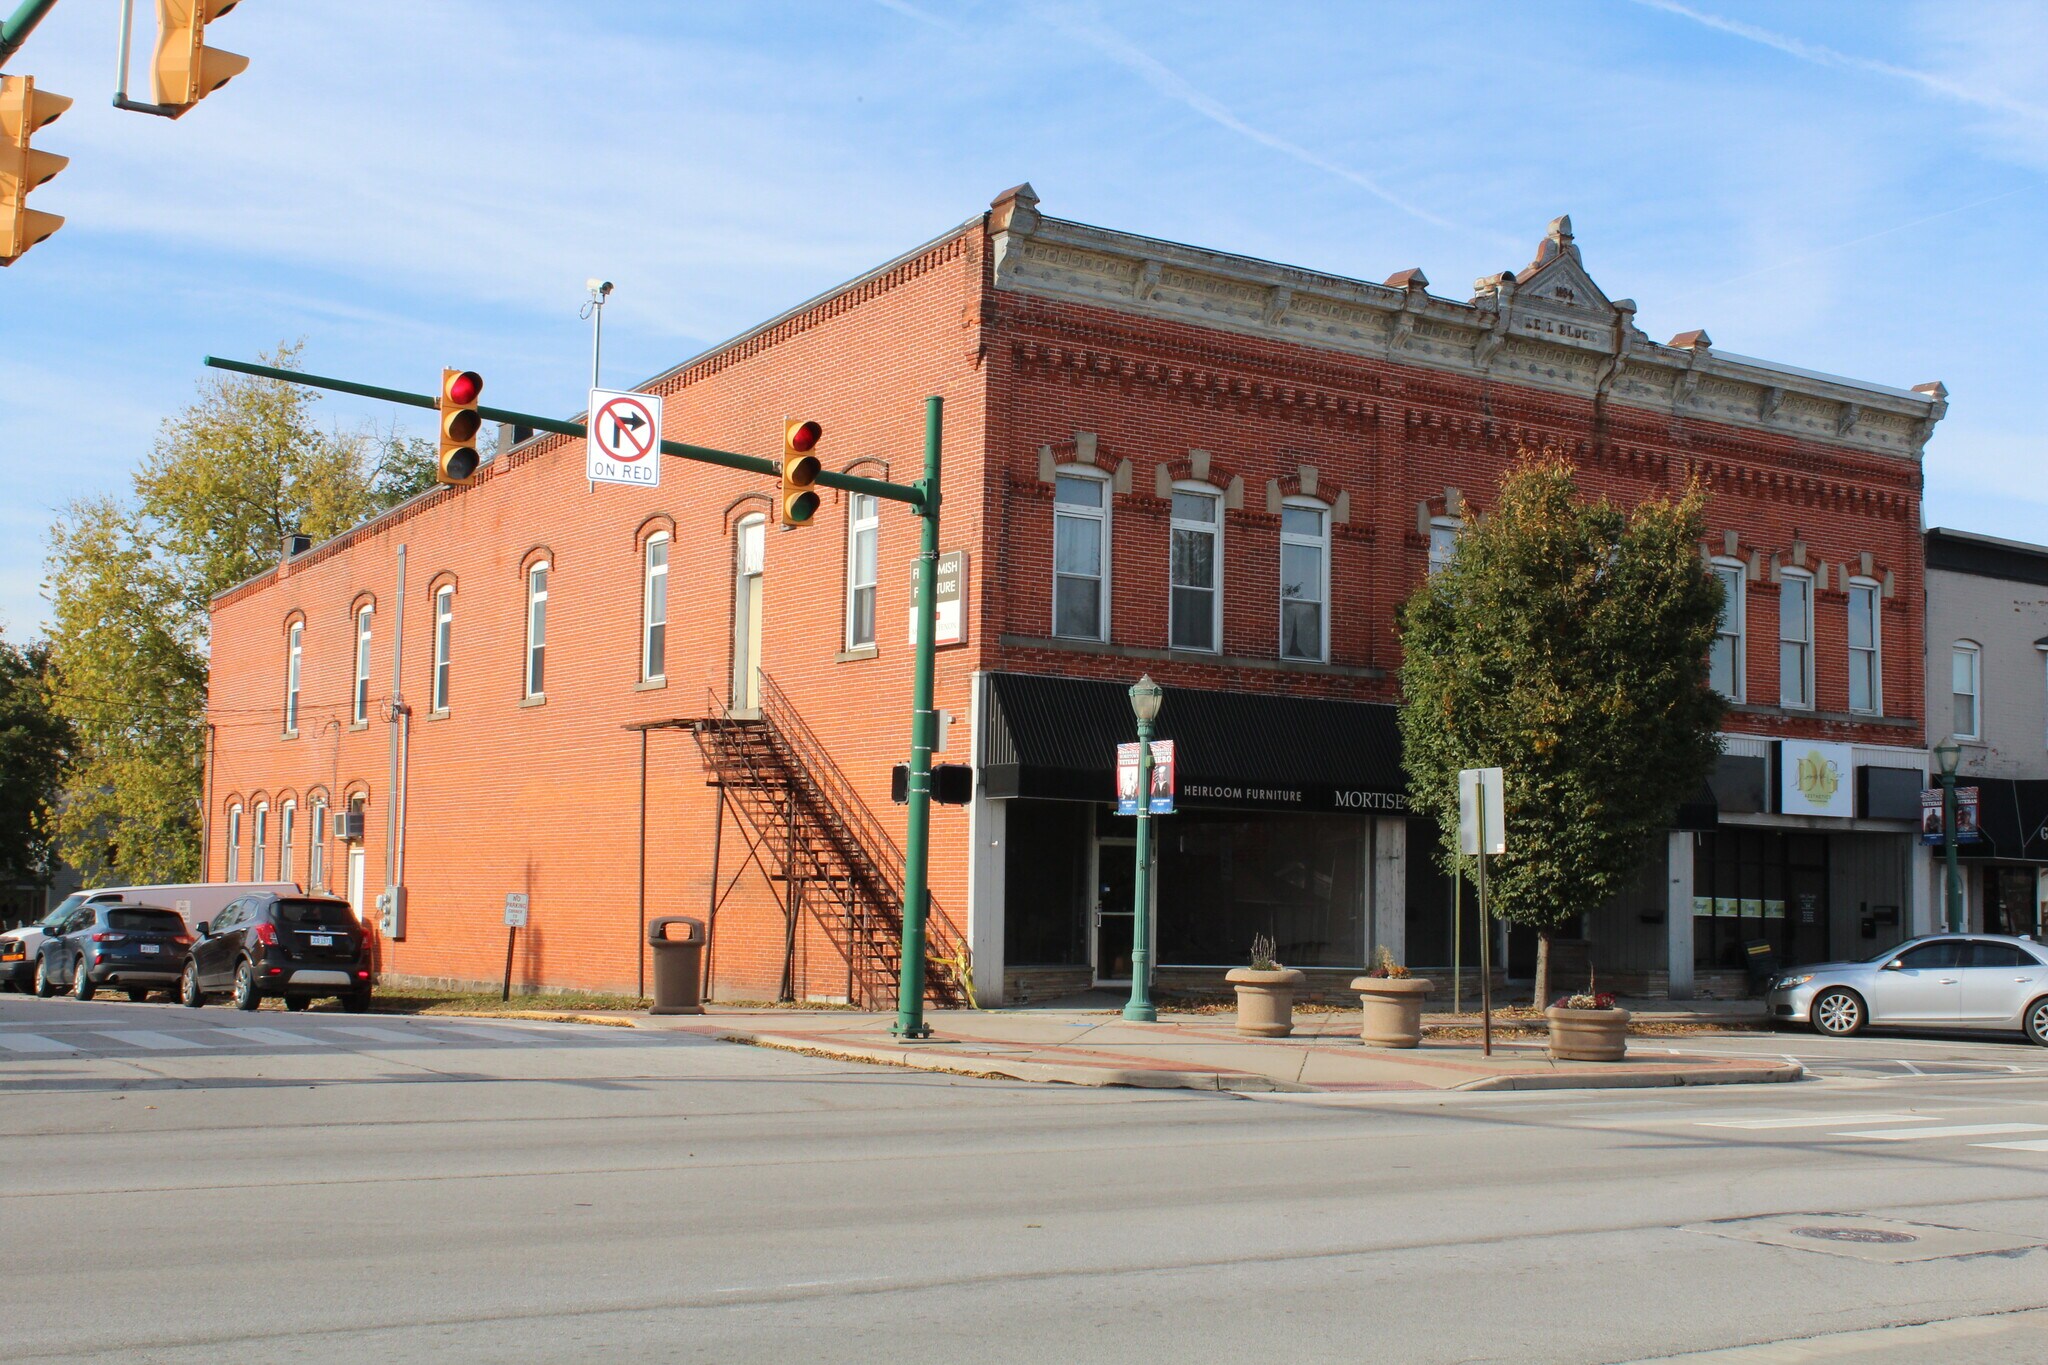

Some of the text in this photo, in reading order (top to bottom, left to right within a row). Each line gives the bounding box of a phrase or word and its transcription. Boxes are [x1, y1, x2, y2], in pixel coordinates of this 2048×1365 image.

[594, 462, 652, 480] ON RED
[937, 560, 958, 576] MISH
[1184, 785, 1302, 802] HEIRLOOM FURNITURE
[1334, 790, 1404, 810] MORTISE
[512, 895, 522, 903] NO
